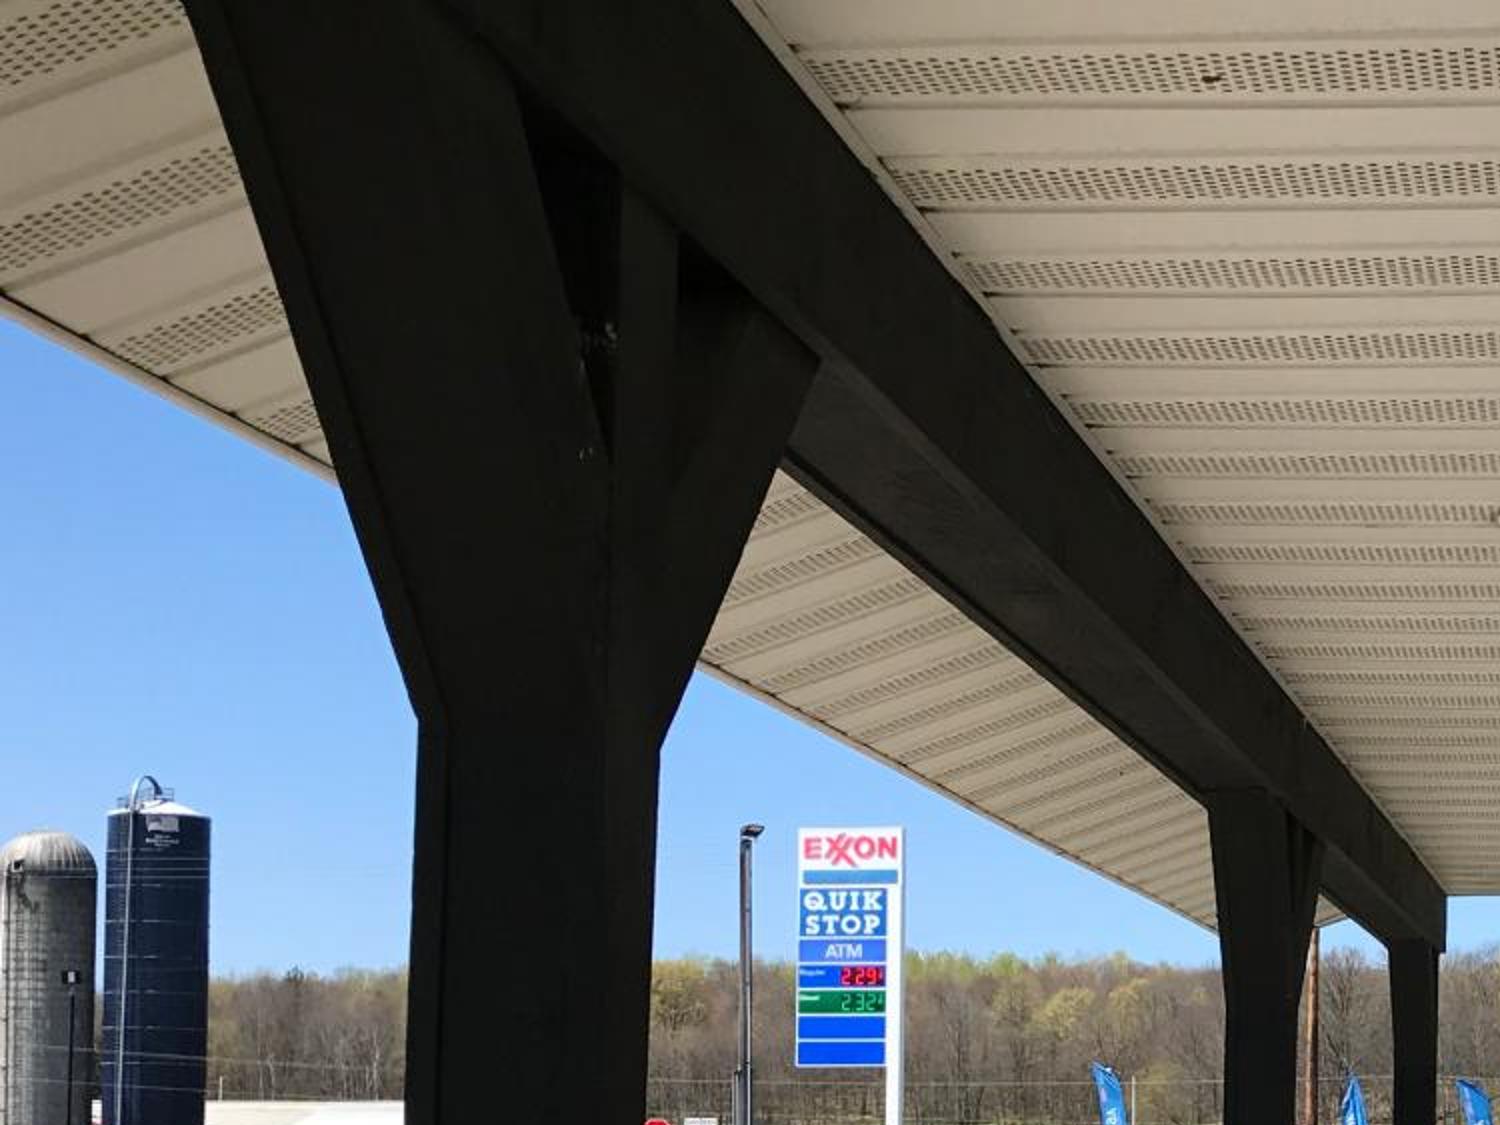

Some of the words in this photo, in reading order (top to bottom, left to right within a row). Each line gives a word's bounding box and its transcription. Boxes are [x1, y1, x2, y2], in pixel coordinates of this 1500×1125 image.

[803, 833, 898, 868] EXXON
[803, 890, 884, 912] QUIK
[804, 914, 881, 936] STOP
[824, 943, 863, 960] ATM
